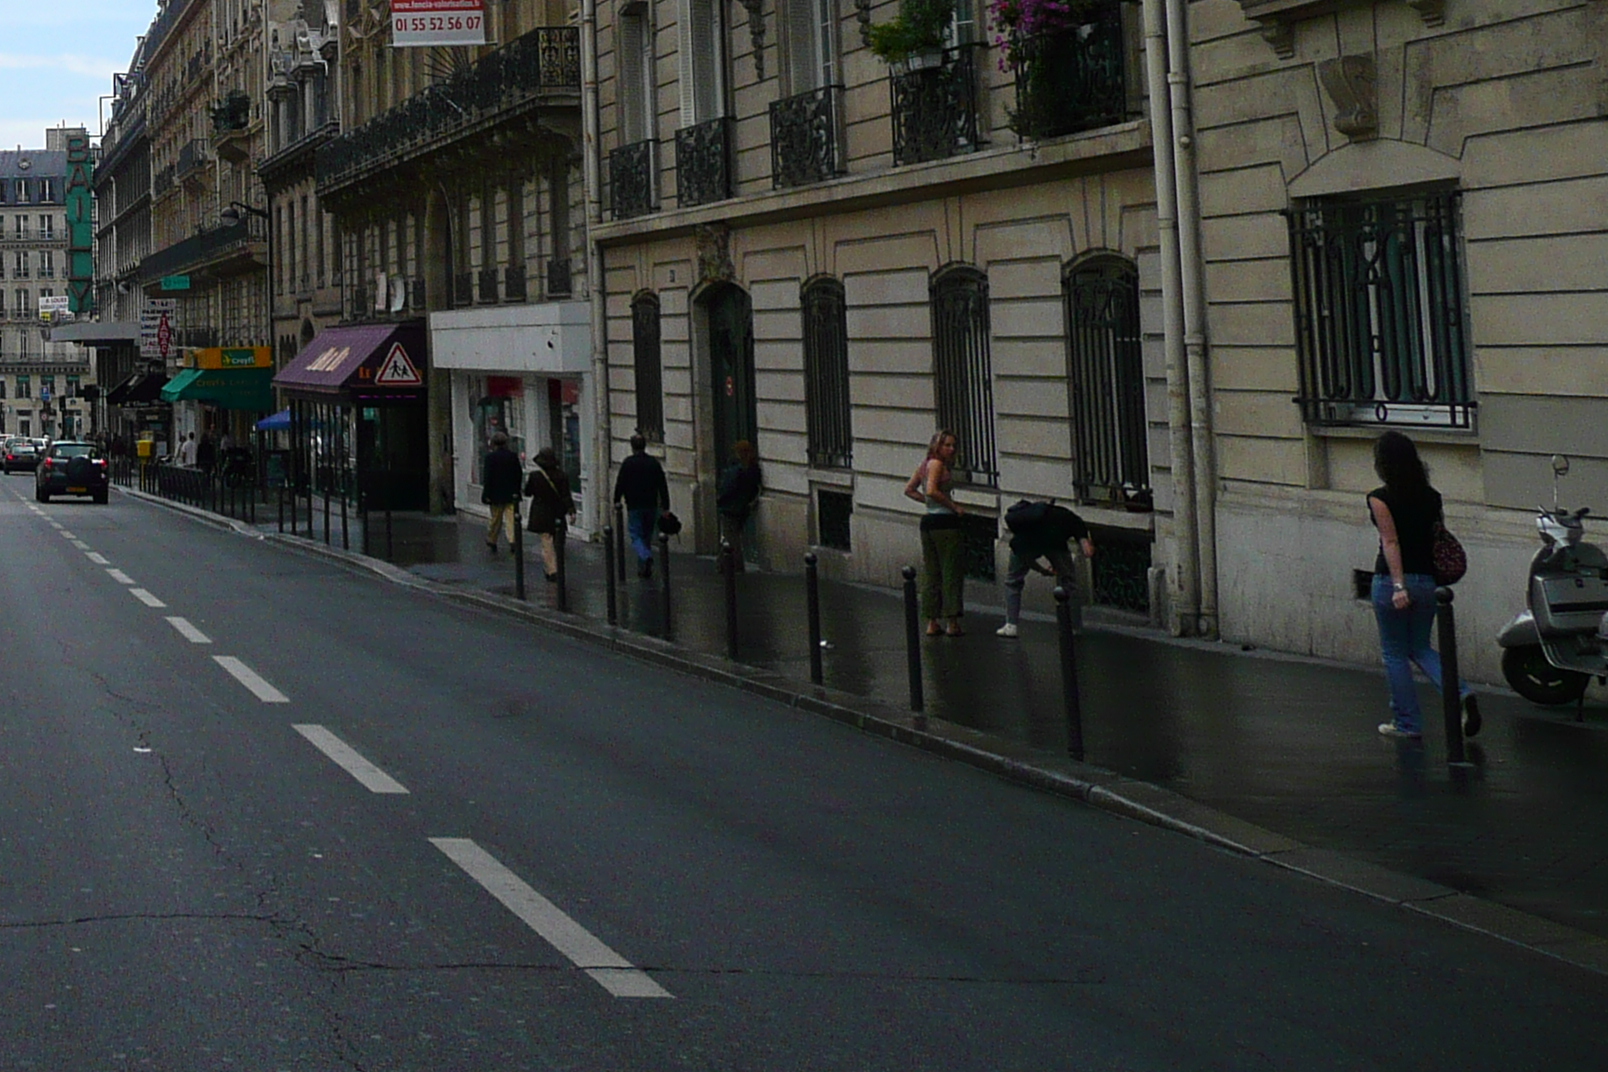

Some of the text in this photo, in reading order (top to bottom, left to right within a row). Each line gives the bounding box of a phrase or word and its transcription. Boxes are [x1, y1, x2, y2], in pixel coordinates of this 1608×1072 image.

[396, 17, 481, 31] 01 55 52 56 07
